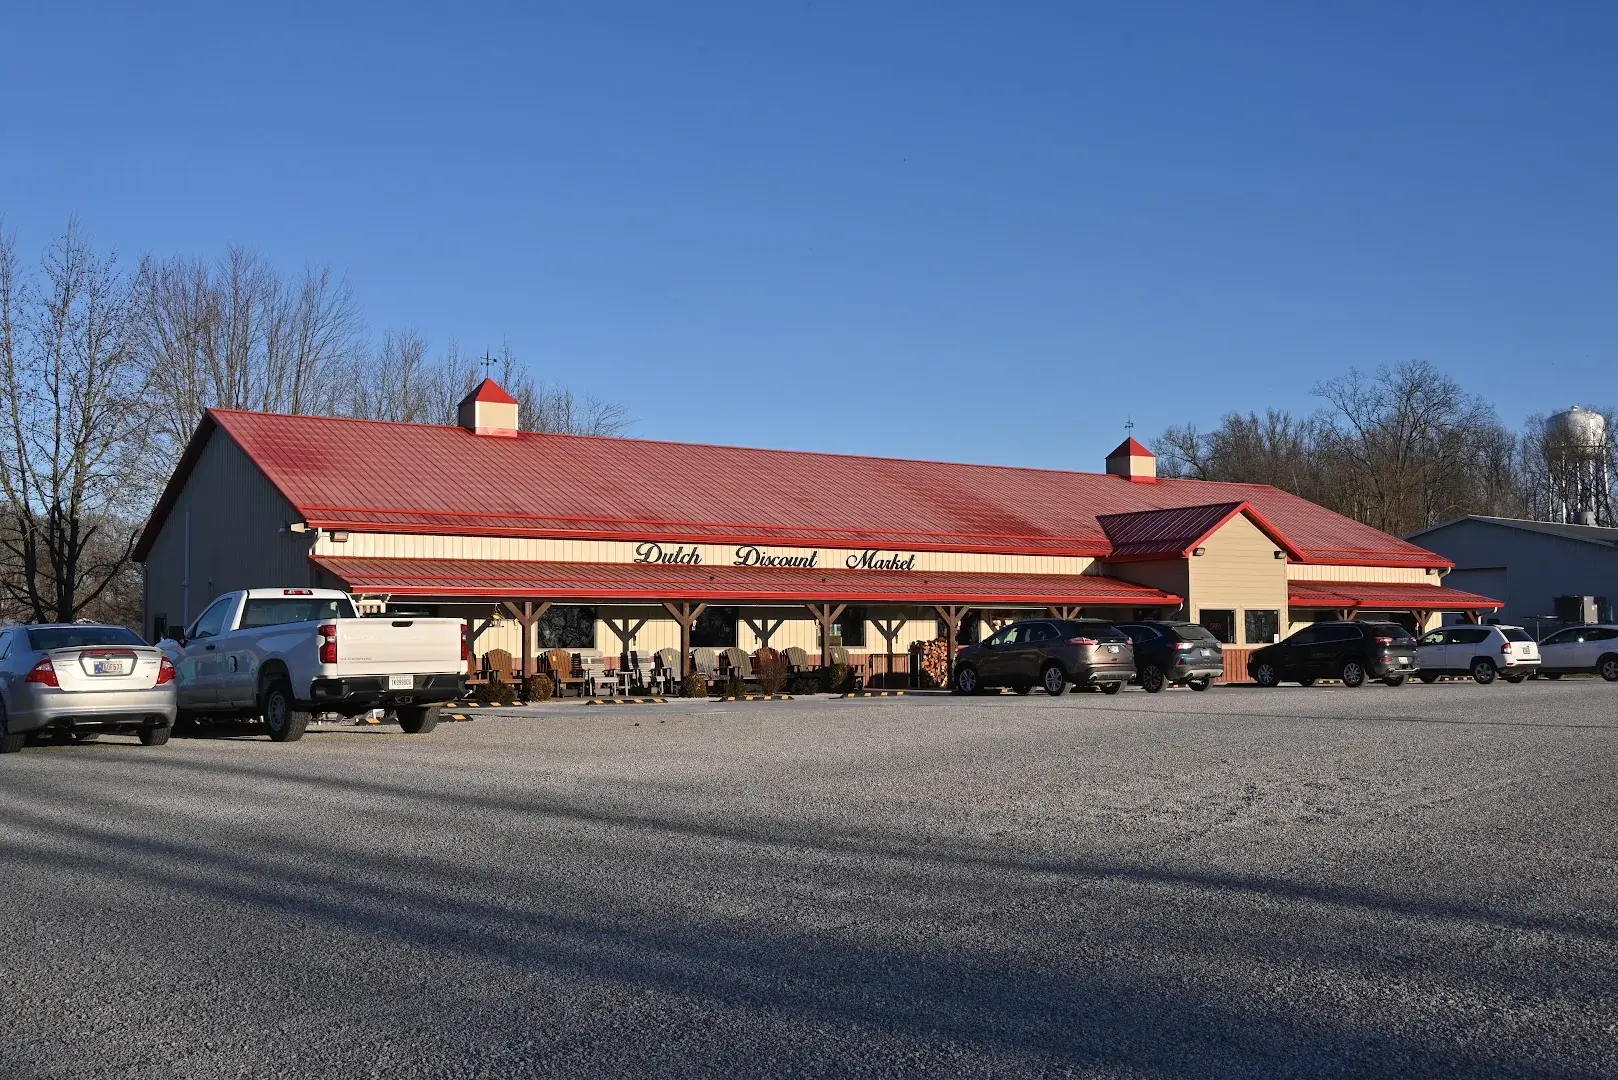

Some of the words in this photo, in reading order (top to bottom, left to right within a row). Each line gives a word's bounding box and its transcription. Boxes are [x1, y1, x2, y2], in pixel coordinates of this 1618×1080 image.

[634, 542, 702, 565] Dutch
[733, 546, 818, 568] Discount
[845, 550, 915, 571] Market
